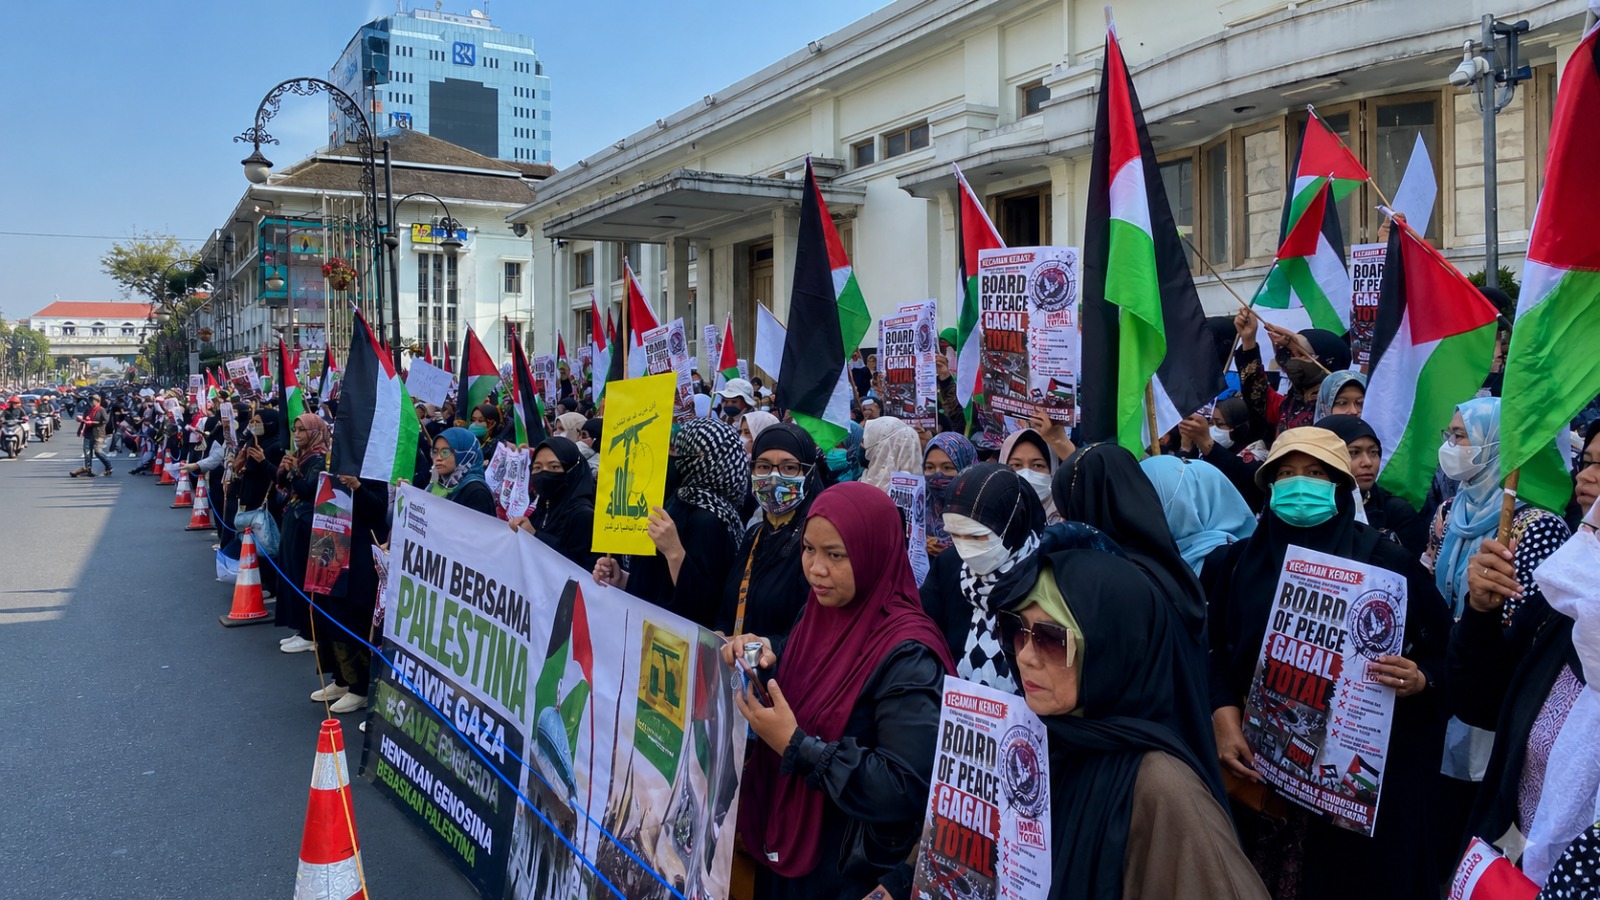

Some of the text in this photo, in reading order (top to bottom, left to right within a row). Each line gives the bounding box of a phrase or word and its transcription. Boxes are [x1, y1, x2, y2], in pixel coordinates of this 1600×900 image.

[982, 275, 1027, 294] BOARD
[1353, 264, 1384, 279] BOAR
[1353, 279, 1365, 291] OF
[982, 295, 1029, 312] OF PEACE
[985, 313, 1025, 332] GAGAL
[1355, 293, 1378, 306] GAG
[1357, 307, 1378, 321] TOT
[986, 331, 1027, 353] TOTAL
[402, 539, 447, 590] KAMI
[449, 561, 531, 643] BERSAMA
[1278, 582, 1347, 627] BOARD
[394, 575, 528, 725] PALESTINA
[1273, 610, 1294, 635] OF
[1294, 617, 1348, 653] PEACE
[1270, 634, 1334, 682] GAGAL
[1266, 660, 1328, 710] TOTAL
[455, 696, 505, 764] GAZA
[942, 720, 997, 772] BOARD
[380, 734, 492, 855] HENTIKAN GENOSINA
[938, 754, 955, 784] OF
[958, 760, 999, 807] PEACE
[376, 758, 476, 868] BEBASKAN PALESTINA
[937, 785, 994, 840] GAGAL
[935, 815, 994, 878] TOTAL
